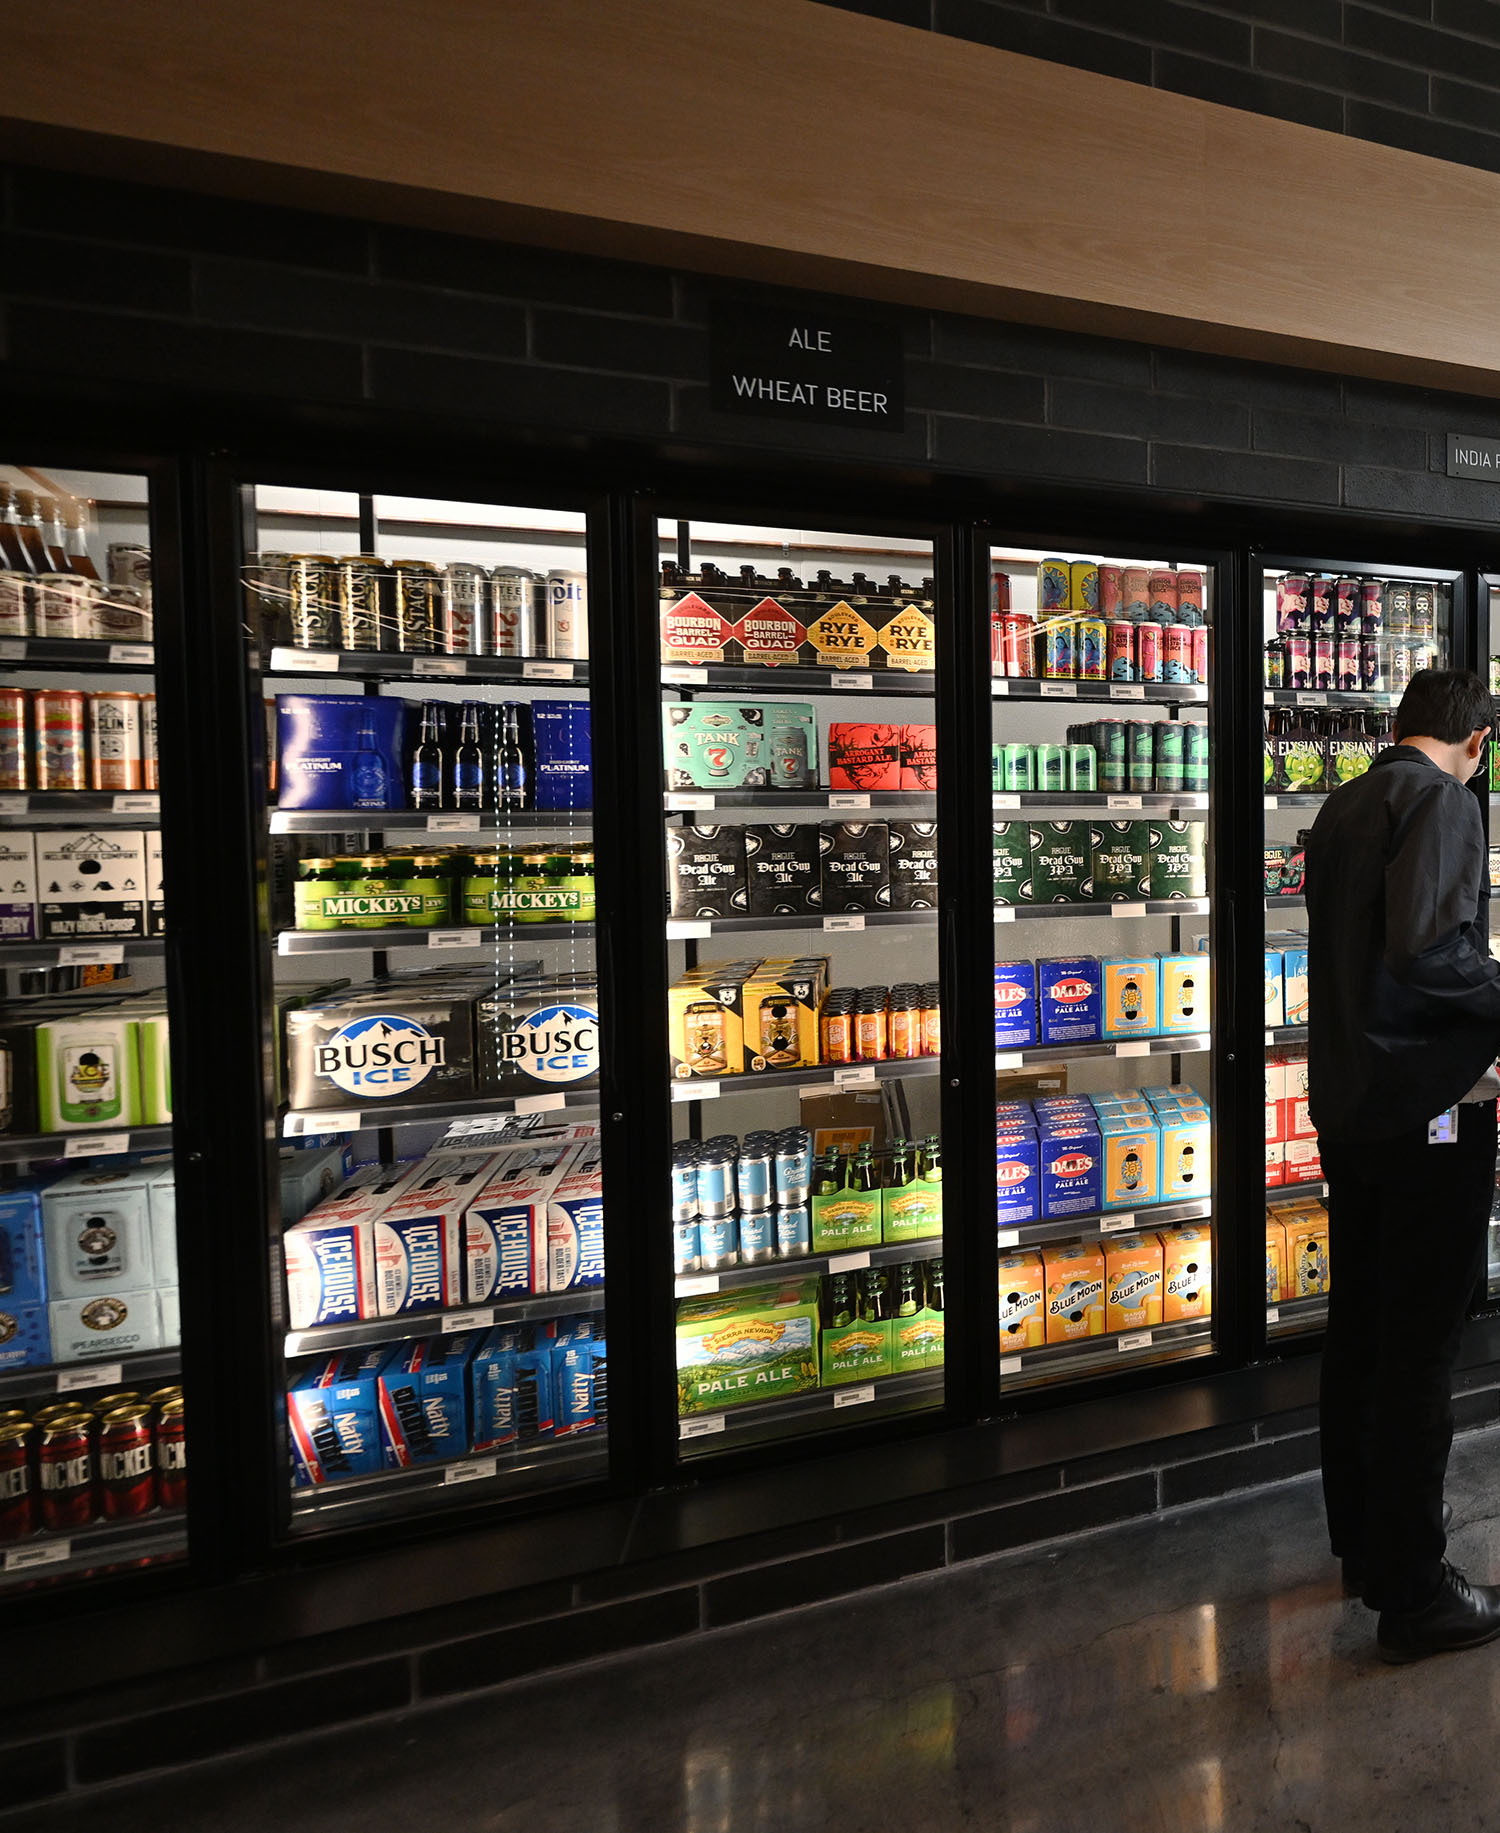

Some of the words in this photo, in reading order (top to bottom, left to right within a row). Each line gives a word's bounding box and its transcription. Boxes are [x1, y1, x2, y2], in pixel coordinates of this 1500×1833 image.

[788, 327, 832, 352] ALE
[732, 375, 818, 405] WHEAT
[827, 387, 888, 414] BEER
[1455, 448, 1491, 468] INDIA
[666, 616, 721, 631] BOURBON
[744, 619, 796, 634] BOURBON
[820, 621, 859, 635] RYE
[676, 628, 713, 636] BARREL
[753, 631, 788, 640] BARREL
[889, 625, 927, 638] RYE
[669, 636, 721, 647] QUAD
[746, 639, 796, 649] QUAD
[825, 635, 865, 648] RYE
[895, 638, 933, 651] RYE
[671, 650, 713, 659] BARREL-AGED
[694, 732, 740, 746] TANK
[775, 747, 804, 757] TANK
[844, 748, 885, 757] ARROGANT
[1278, 741, 1324, 756] ELYSIAN
[1330, 741, 1374, 756] ELYSIAN
[708, 748, 727, 767] 7
[836, 756, 870, 764] BASTARD
[540, 764, 589, 772] PLATINUM
[783, 758, 797, 772] 7
[694, 853, 719, 862] ROGUE
[771, 851, 795, 860] ROGUE
[843, 851, 866, 860] ROGUE
[912, 850, 934, 858] ROGUE
[1039, 856, 1063, 865] Dead
[1065, 855, 1084, 866] Guy
[1099, 854, 1123, 864] Dead
[1123, 853, 1142, 865] Guy
[1157, 853, 1179, 864] Dead
[678, 863, 708, 875] Dead
[710, 862, 735, 876] Guy
[757, 861, 786, 873] Dead
[787, 861, 811, 874] Guy
[829, 861, 856, 873] Dead
[858, 861, 881, 874] Guy
[898, 859, 926, 870] Dead
[1050, 864, 1074, 875] IPA
[1109, 862, 1133, 874] IPA
[698, 875, 717, 886] Ale
[775, 872, 793, 883] Ale
[846, 872, 864, 883] Ale
[913, 870, 931, 880] Ale
[1008, 1009, 1023, 1018] ALE
[1055, 1006, 1073, 1014] PALE
[319, 1038, 443, 1073] BUSCH
[537, 1055, 589, 1071] ICE
[352, 1068, 411, 1085] ICE
[1055, 1180, 1073, 1189] PALE
[1075, 1178, 1089, 1186] ALE
[892, 1218, 918, 1228] PALE
[921, 1214, 941, 1224] ALE
[821, 1227, 849, 1237] PALE
[852, 1224, 873, 1234] ALE
[573, 1205, 604, 1286] ICEHOUSE
[493, 1214, 528, 1296] ICEHOUSE
[402, 1224, 440, 1309] ICEHOUSE
[313, 1235, 356, 1322] ICEHOUSE
[1109, 1285, 1135, 1304] BLUE
[1136, 1272, 1160, 1290] MOON
[1168, 1279, 1192, 1294] BLUE
[1015, 1292, 1041, 1310] MOON
[1050, 1295, 1076, 1314] BLUE
[1077, 1281, 1103, 1300] MOON
[714, 1327, 745, 1344] SIERRA
[746, 1325, 775, 1337] NEVADA
[901, 1348, 926, 1358] PALE
[832, 1359, 859, 1370] PALE
[862, 1354, 883, 1364] ALE
[698, 1373, 749, 1396] PALE
[755, 1367, 793, 1383] ALE
[570, 1372, 596, 1414] Natty
[492, 1387, 519, 1429] Natty
[423, 1396, 451, 1438] Natty
[333, 1411, 365, 1455] Natty
